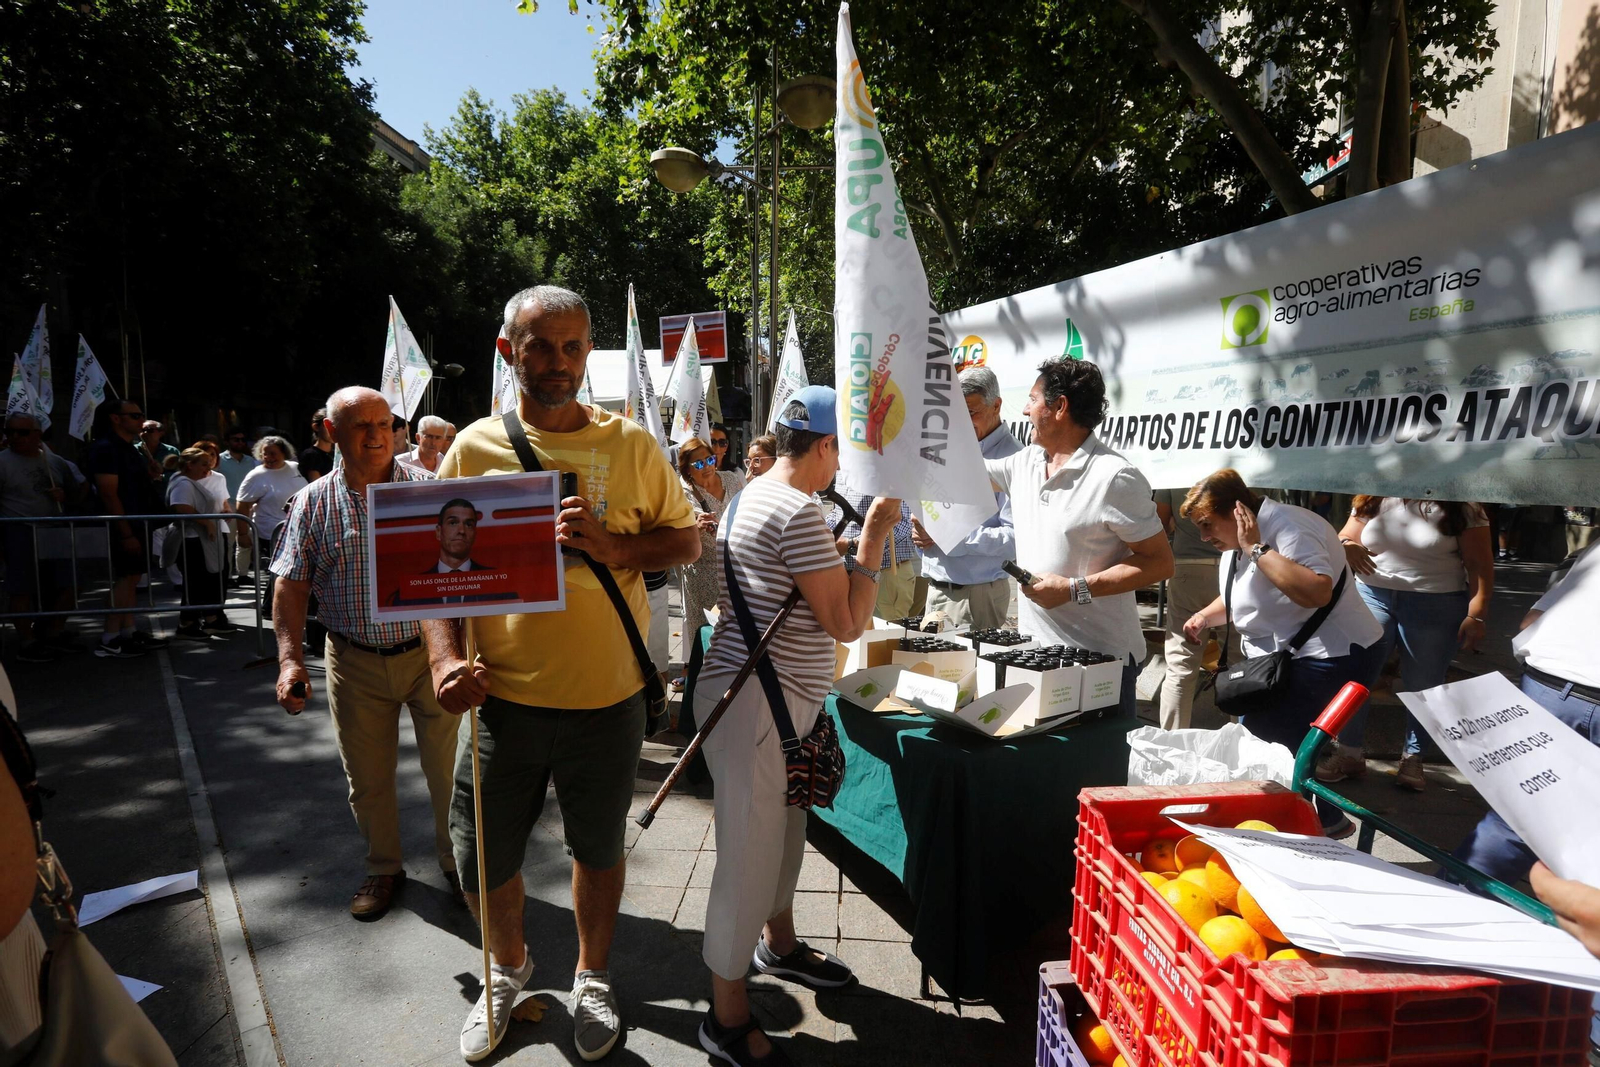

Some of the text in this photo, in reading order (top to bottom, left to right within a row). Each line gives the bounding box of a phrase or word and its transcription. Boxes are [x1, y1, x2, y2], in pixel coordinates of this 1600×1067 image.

[1273, 256, 1422, 301] cooperativas
[1274, 268, 1482, 325] agro-alimentarias
[1409, 299, 1475, 322] España
[952, 342, 983, 365] AG
[1100, 412, 1177, 451] HARTOS
[1177, 410, 1209, 450] DE
[1210, 407, 1259, 450] LOS
[1261, 393, 1447, 448] CONTINUOS
[1446, 379, 1600, 443] ATAQU
[448, 583, 481, 592] DESAYUNAR
[467, 573, 493, 582] MAÑANA
[1475, 715, 1497, 733] nos
[1491, 704, 1529, 725] vamos
[1468, 731, 1554, 777] que tenemos que
[1519, 769, 1561, 795] comer
